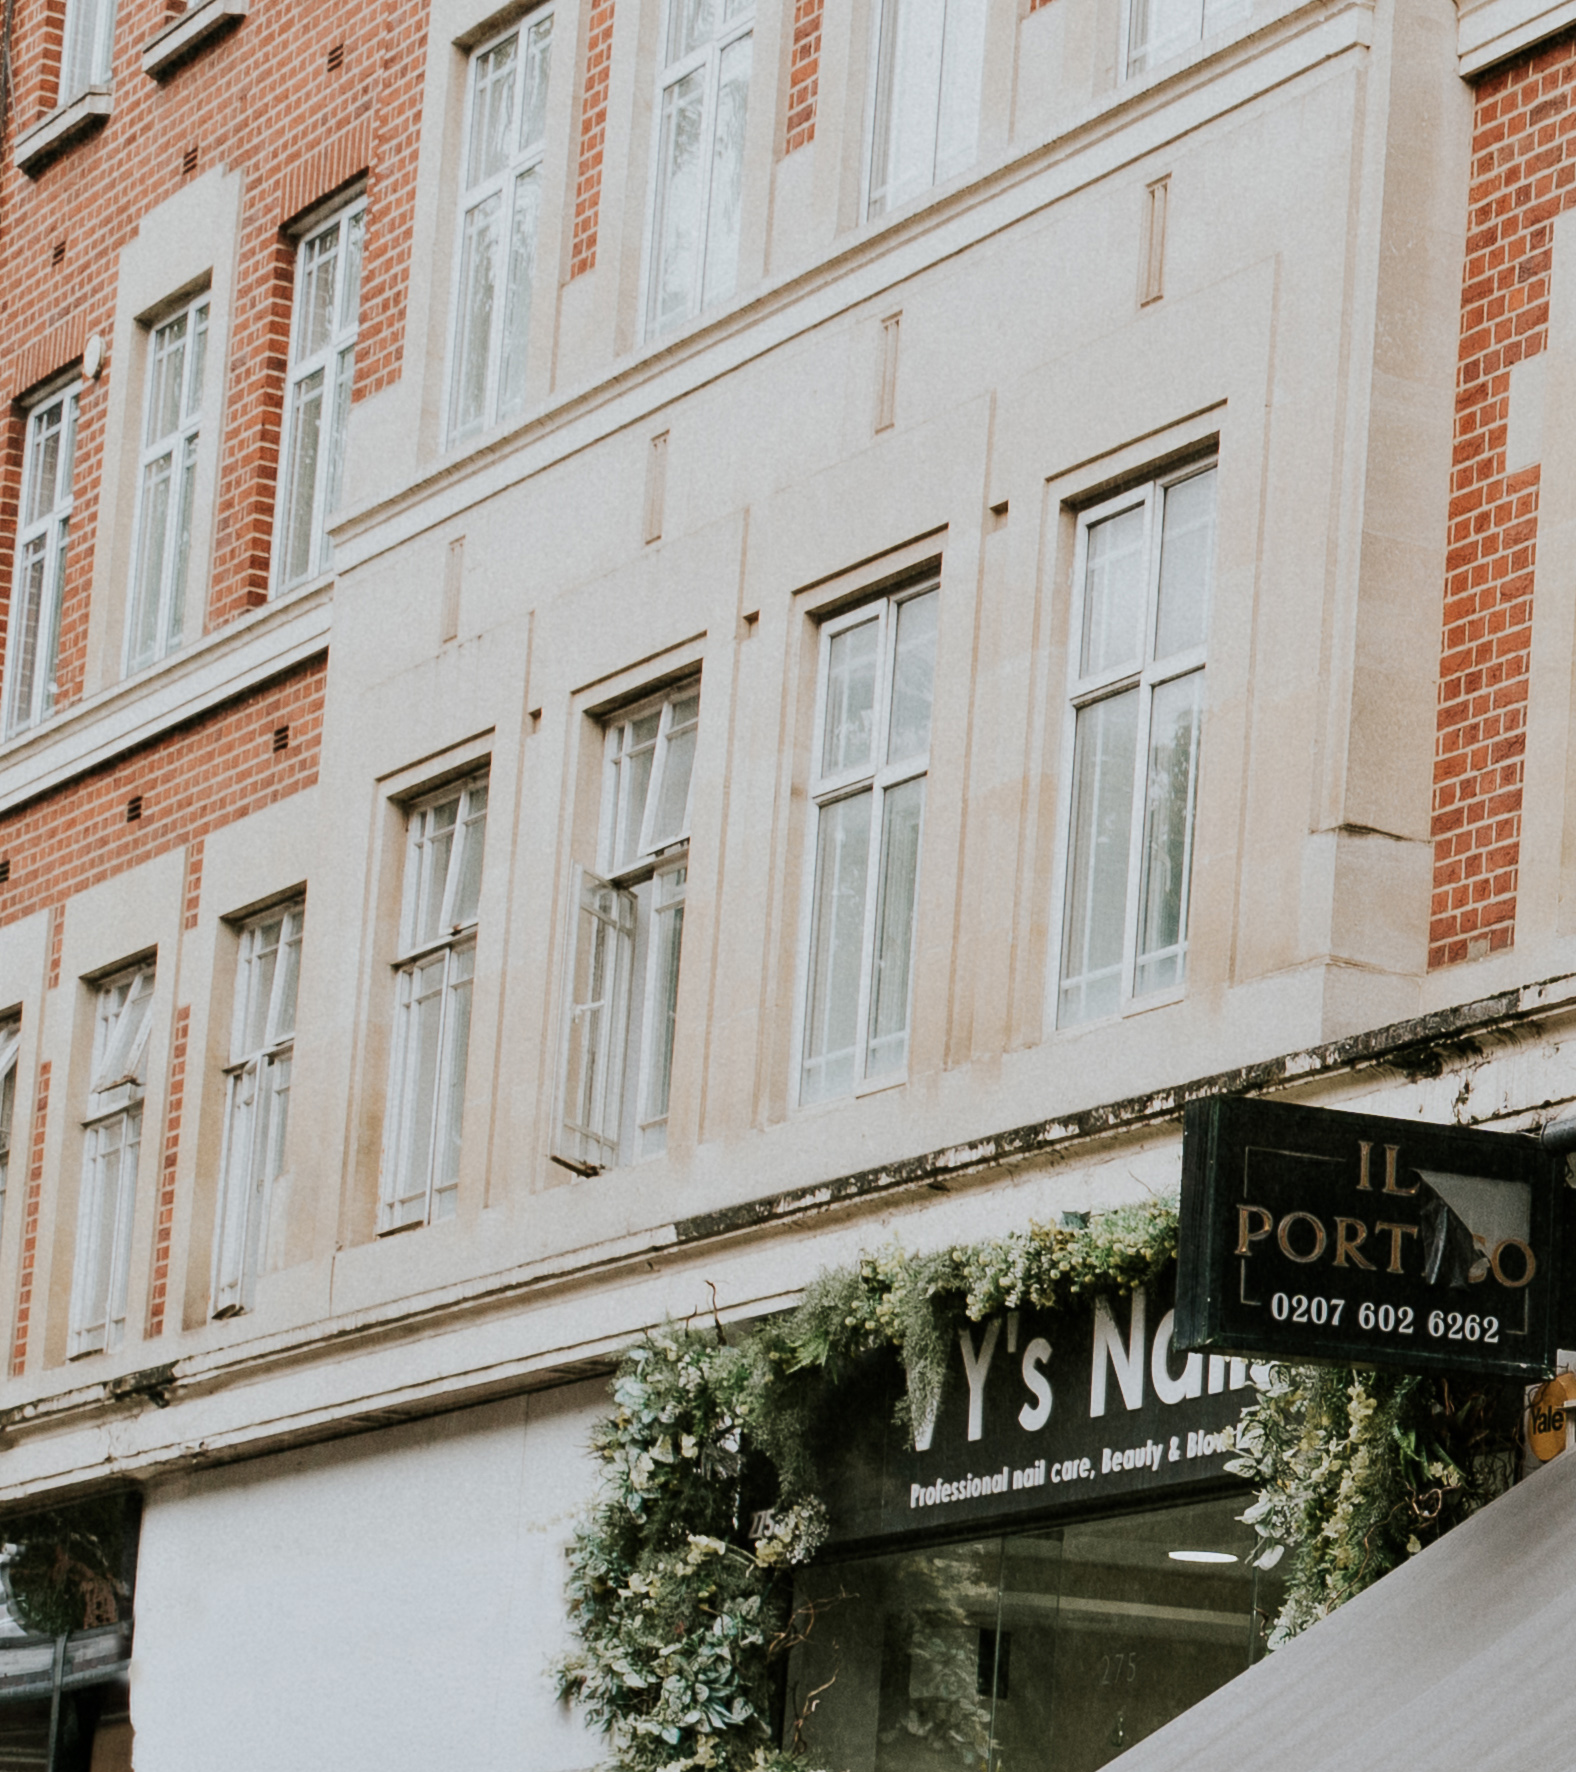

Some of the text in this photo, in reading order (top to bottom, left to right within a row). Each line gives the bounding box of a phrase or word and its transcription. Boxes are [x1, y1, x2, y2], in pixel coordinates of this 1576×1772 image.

[1357, 1140, 1420, 1196] IL
[1271, 1292, 1501, 1344] 0207 602 6262
[1531, 1406, 1565, 1436] Yale
[910, 1467, 1009, 1508] Professional
[1013, 1460, 1045, 1490] nail
[1051, 1456, 1096, 1483] care,
[1102, 1440, 1163, 1474] Beauty
[1168, 1436, 1180, 1462] &
